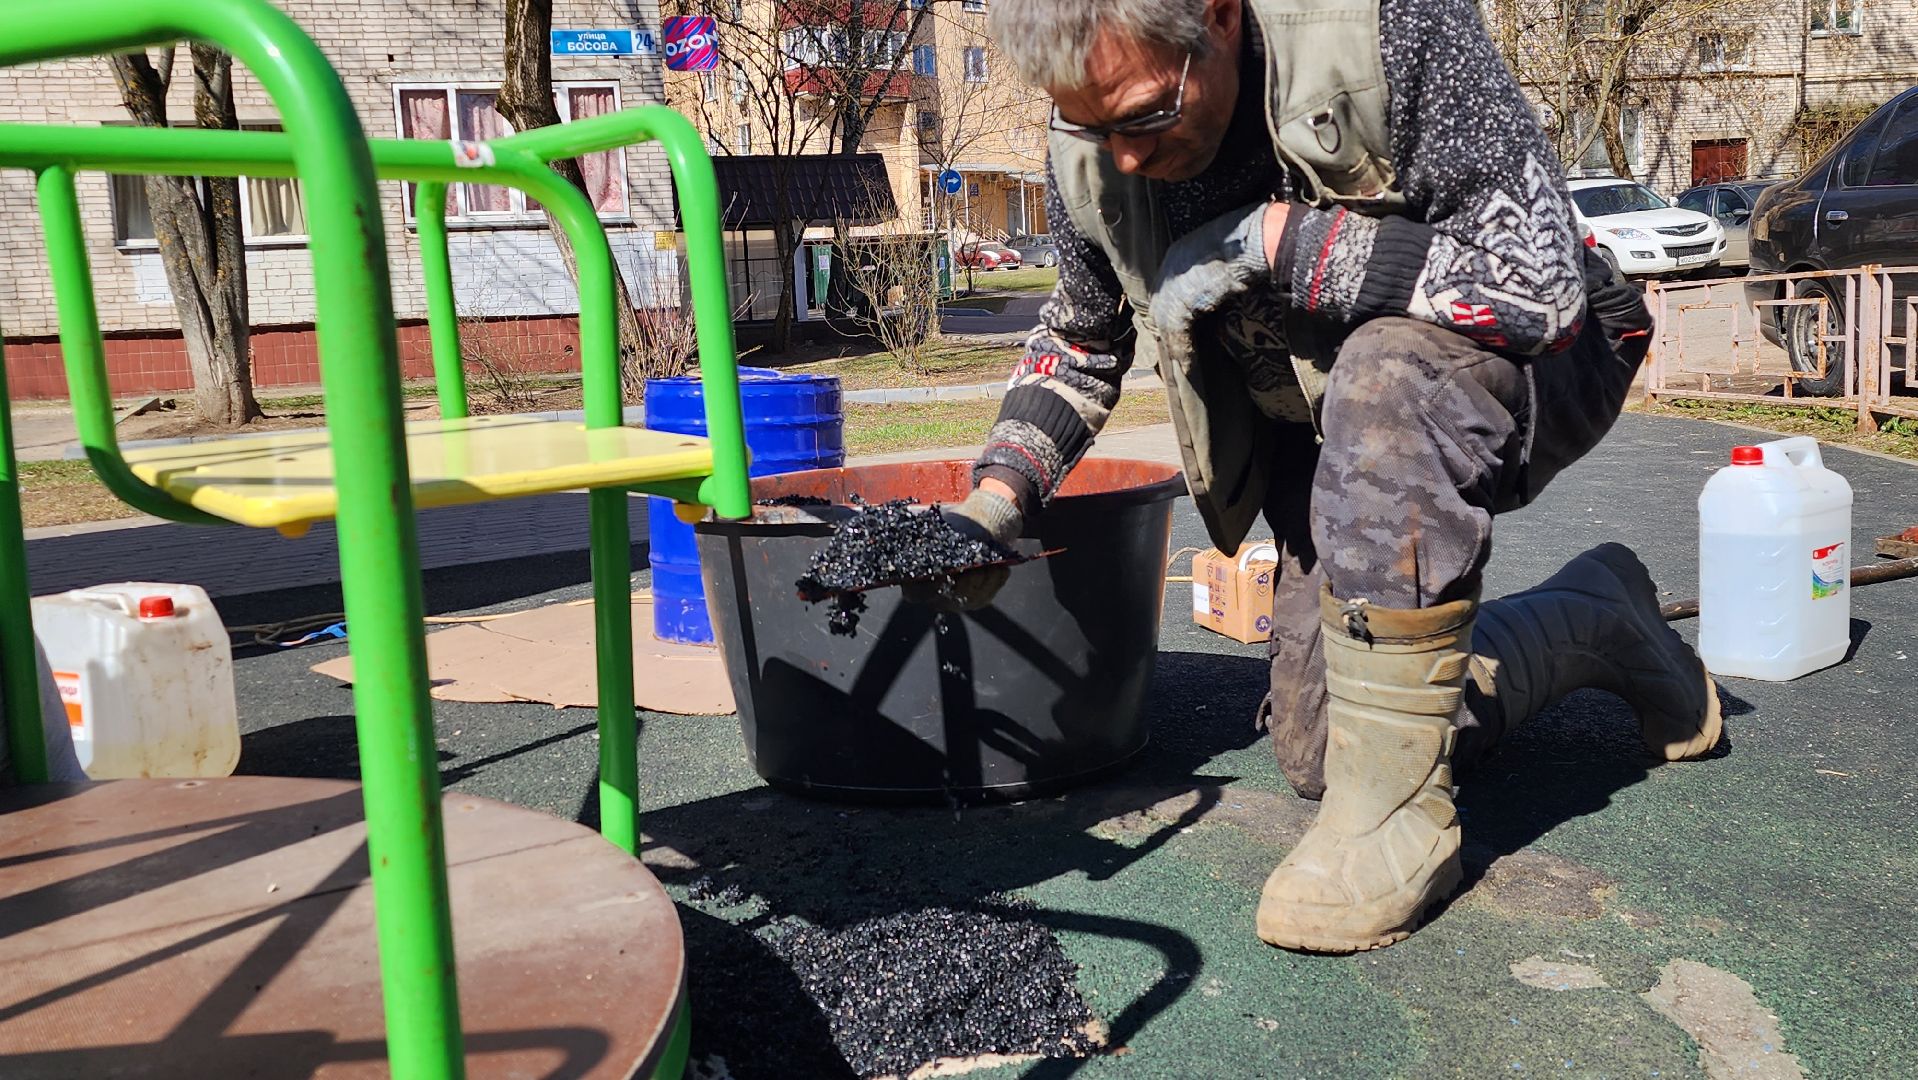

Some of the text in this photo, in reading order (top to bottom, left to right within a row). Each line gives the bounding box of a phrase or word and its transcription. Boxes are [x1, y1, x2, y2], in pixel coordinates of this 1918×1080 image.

[567, 42, 618, 51] БОСОВА
[635, 33, 655, 50] 24
[665, 30, 719, 56] OZON
